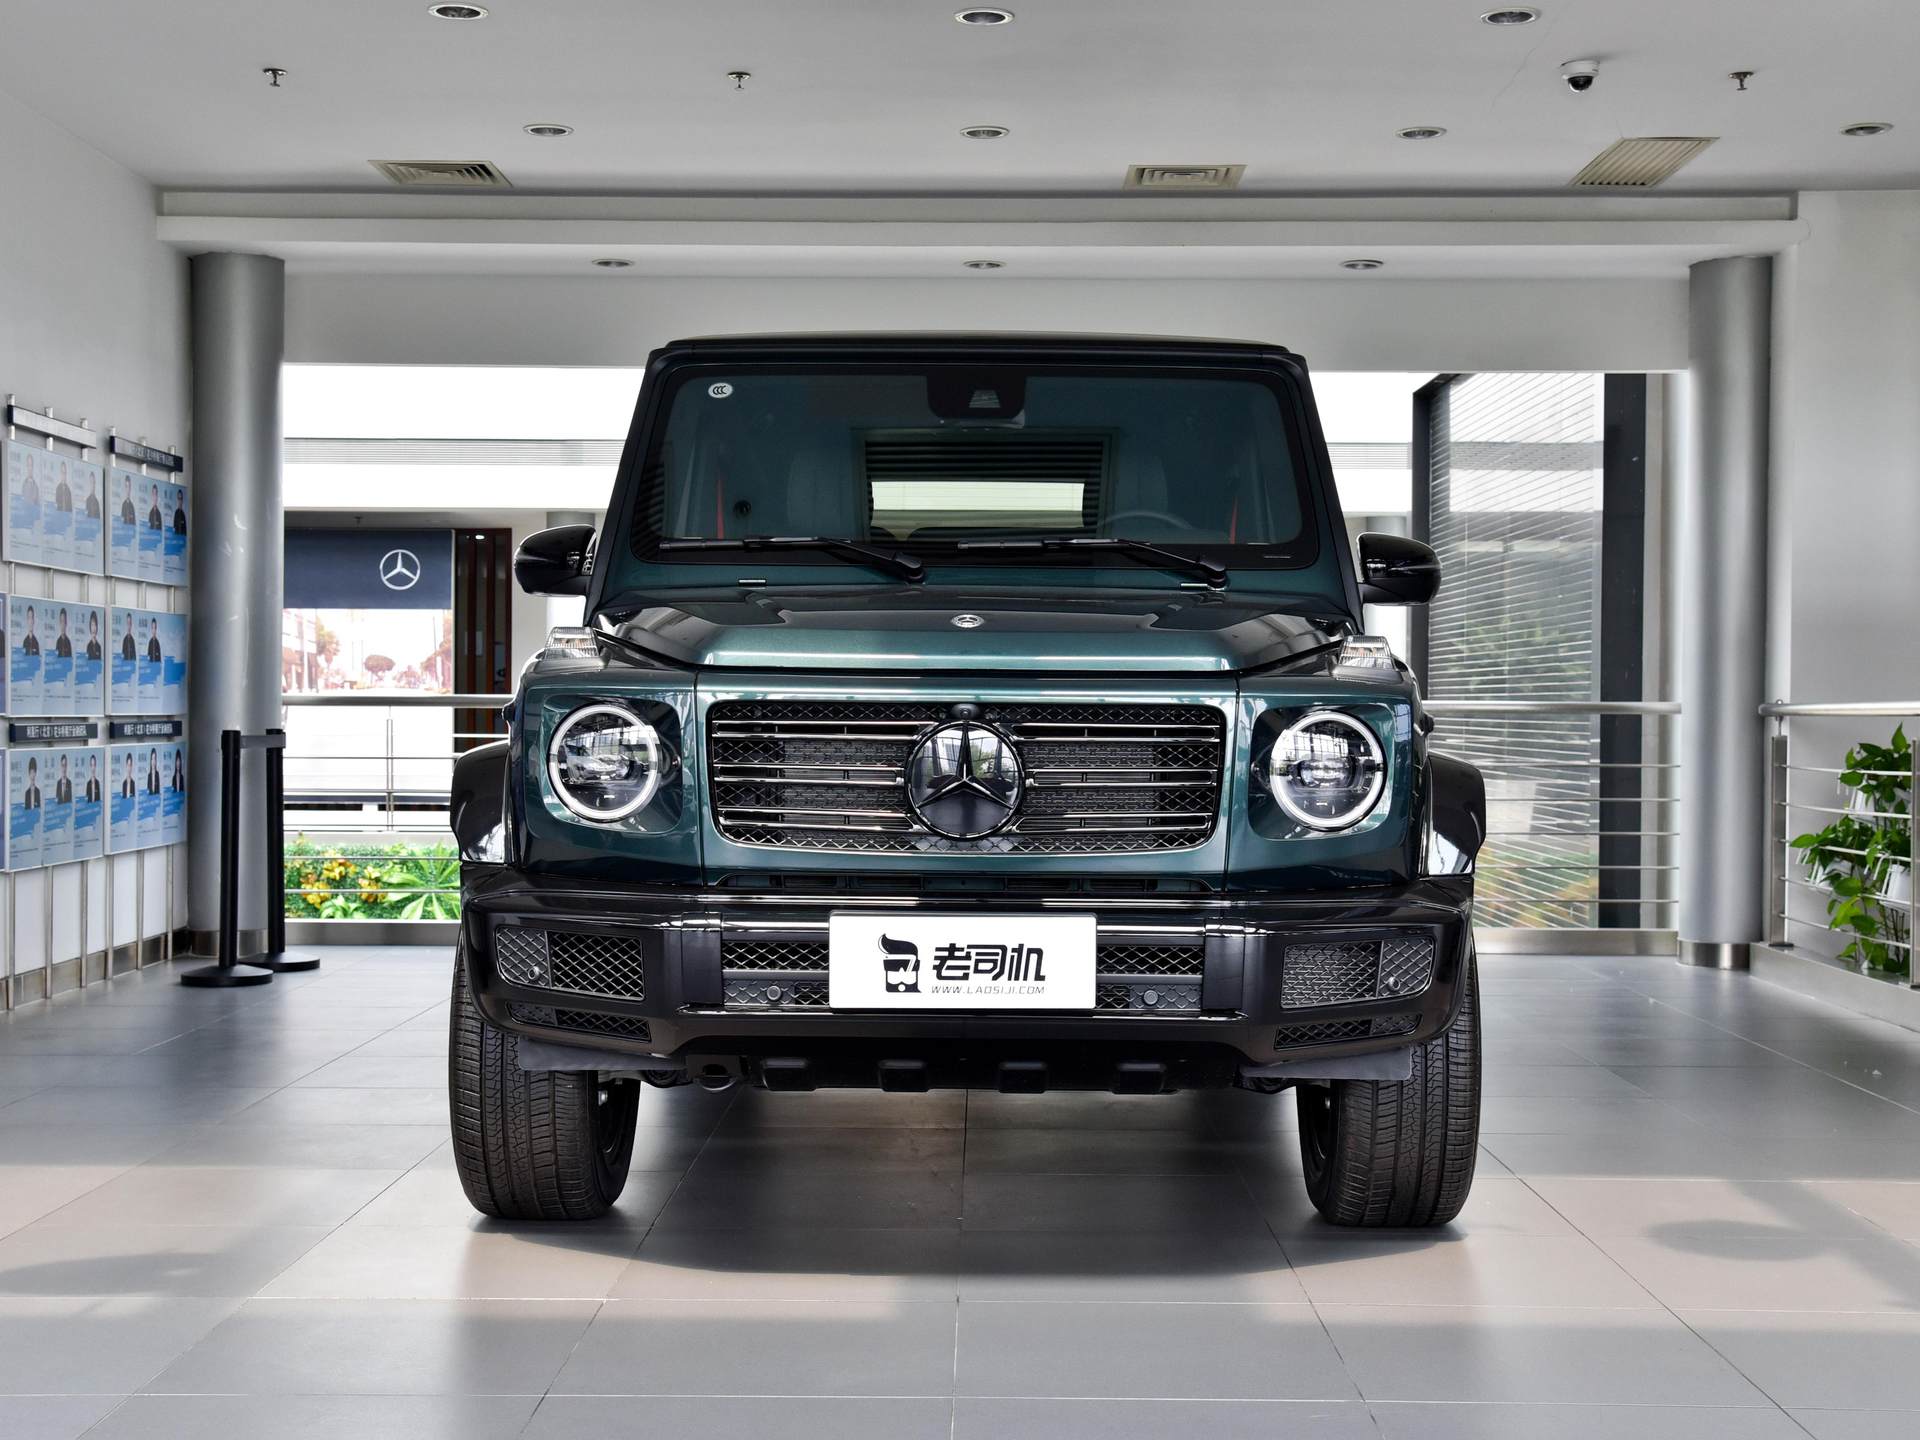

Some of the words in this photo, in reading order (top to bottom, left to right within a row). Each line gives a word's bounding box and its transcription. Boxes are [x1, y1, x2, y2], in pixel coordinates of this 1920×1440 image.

[932, 943, 1046, 981] 老司机
[931, 985, 1045, 995] WWW.LAOSIJI.COM
